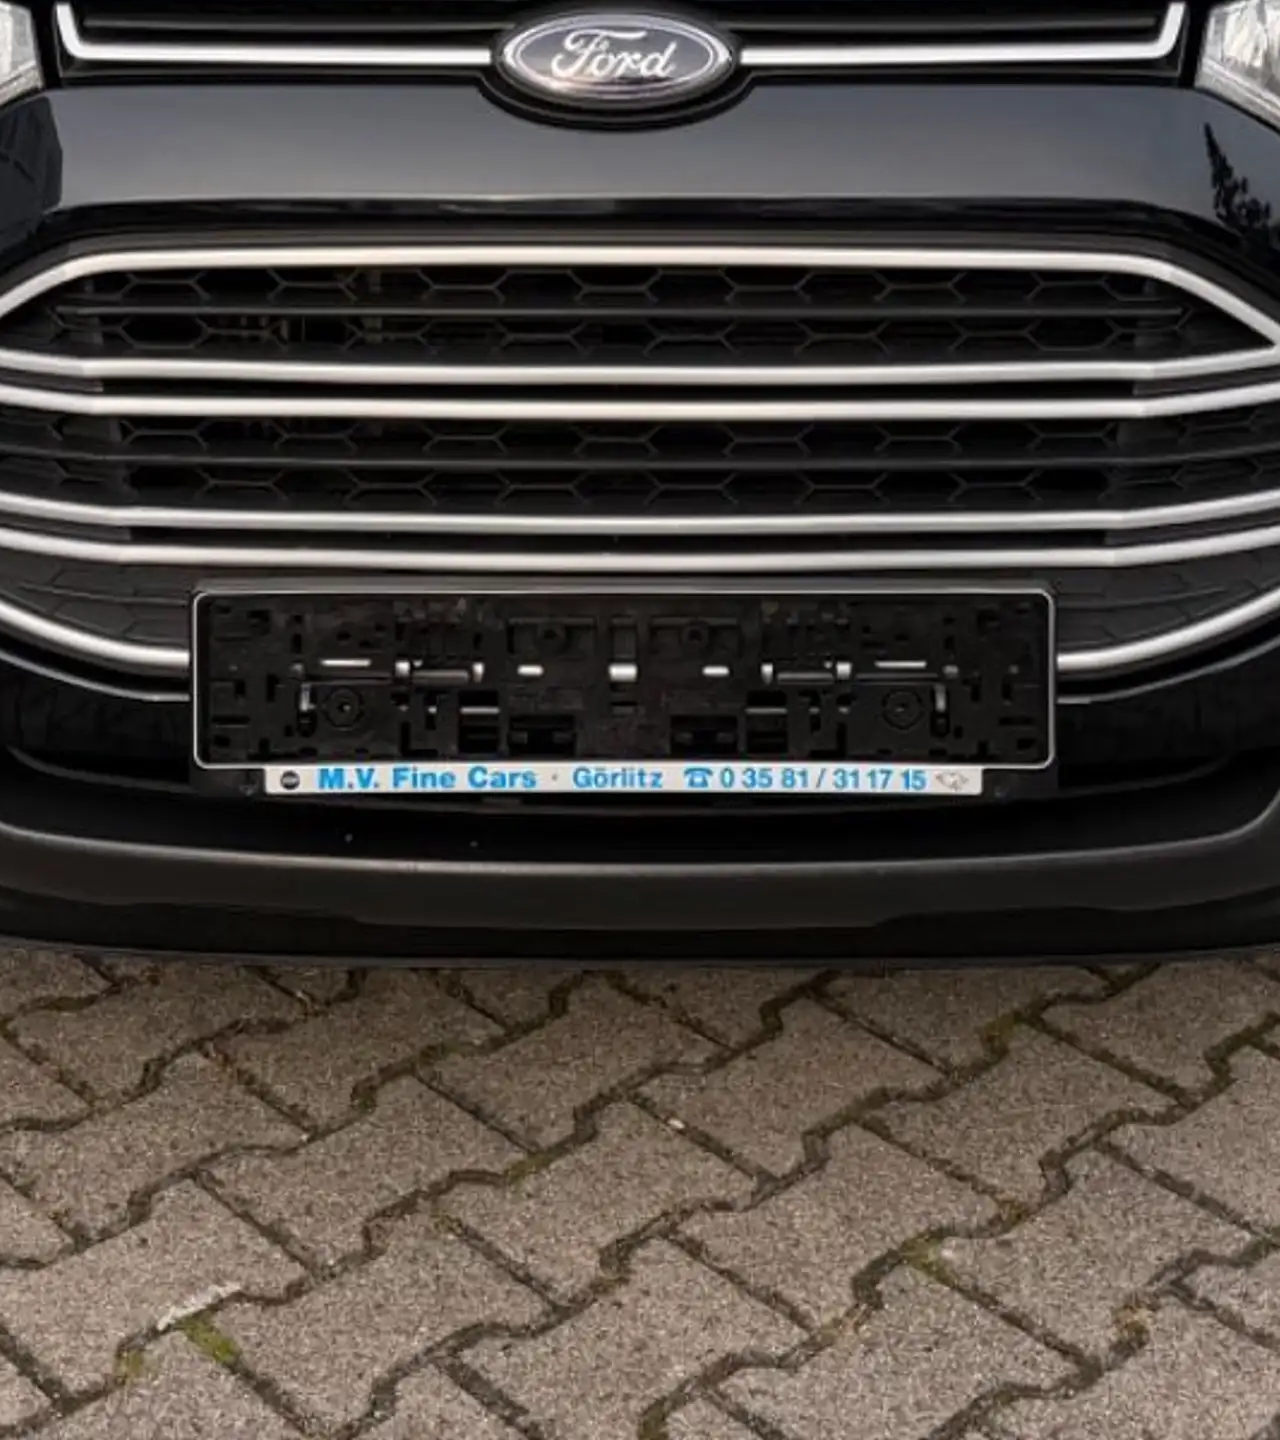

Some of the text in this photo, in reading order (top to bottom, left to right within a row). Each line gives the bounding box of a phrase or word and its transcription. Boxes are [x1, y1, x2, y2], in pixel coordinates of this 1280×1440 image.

[551, 27, 677, 78] Ford
[318, 767, 380, 790] M.V.
[392, 766, 456, 790] Fine
[467, 766, 538, 790] Cars
[572, 765, 663, 790] Görlitz
[719, 768, 735, 790] 0
[741, 768, 773, 790] 35
[901, 768, 927, 791] 15
